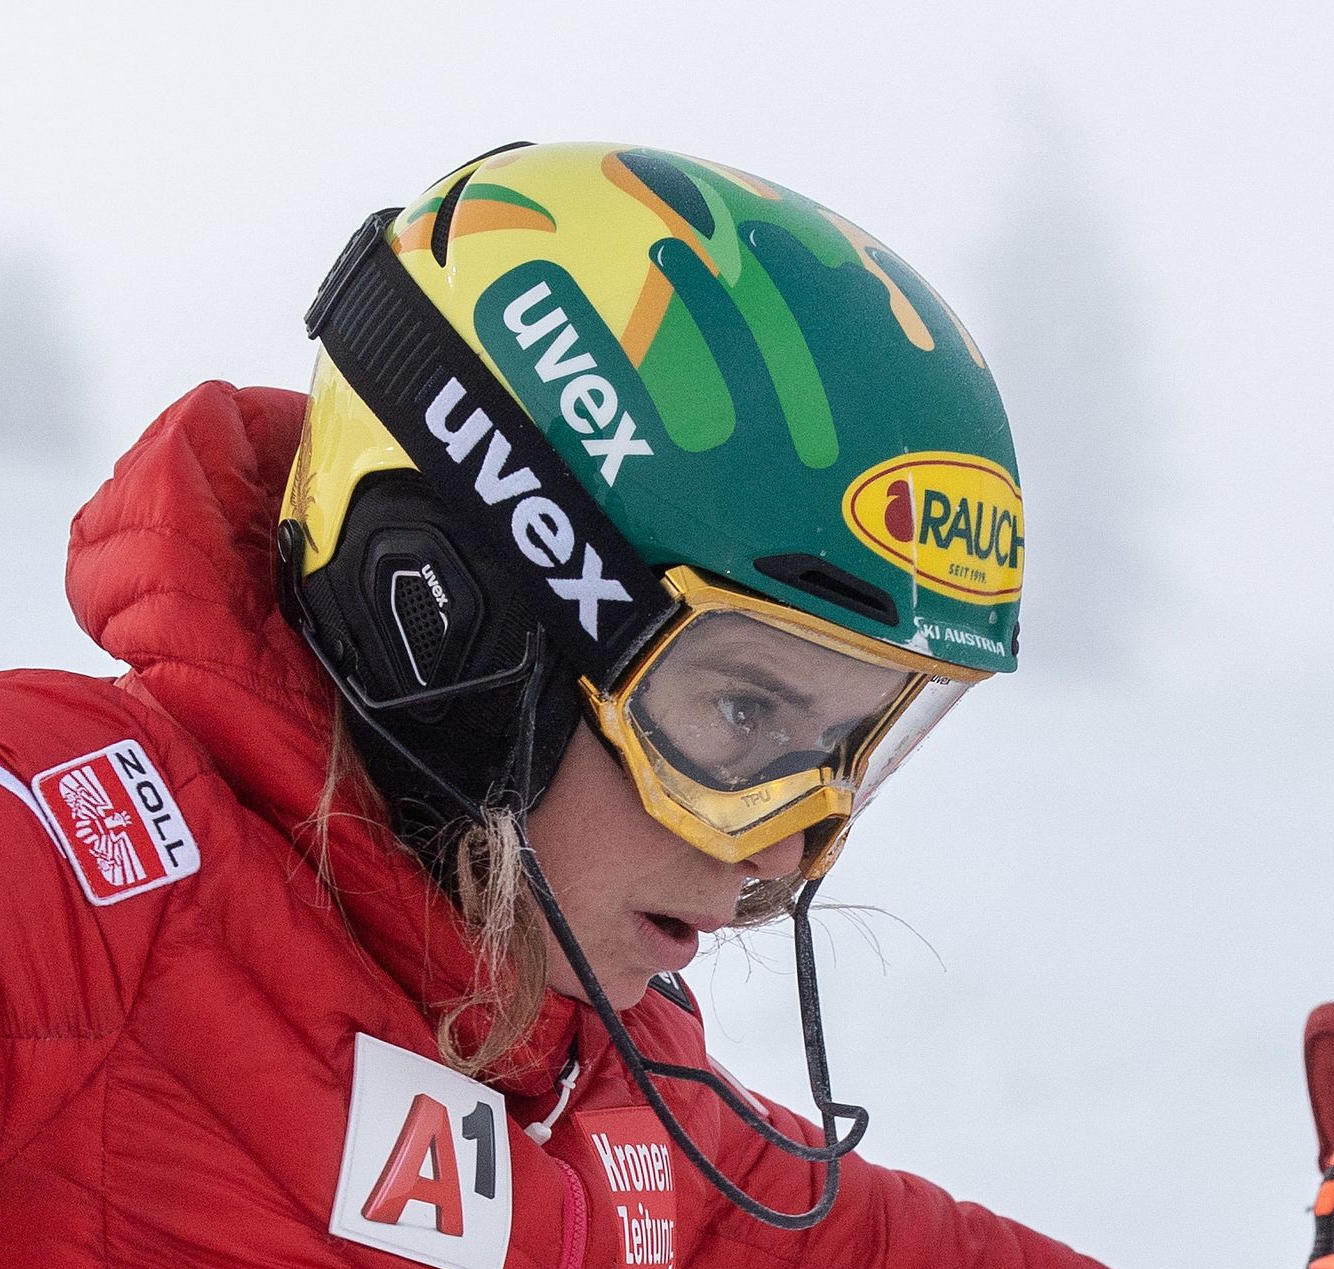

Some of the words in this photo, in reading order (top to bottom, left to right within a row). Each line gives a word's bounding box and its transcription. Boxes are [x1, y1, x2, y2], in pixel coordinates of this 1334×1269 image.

[503, 280, 655, 487] uvex
[424, 376, 634, 642] uvex
[421, 563, 449, 608] uvex
[948, 563, 970, 579] SEIT
[944, 627, 1006, 657] AUSTRIA
[113, 748, 185, 868] ZOLL
[740, 789, 772, 808] TPU
[361, 1092, 497, 1237] A1
[591, 1132, 674, 1193] Kronen
